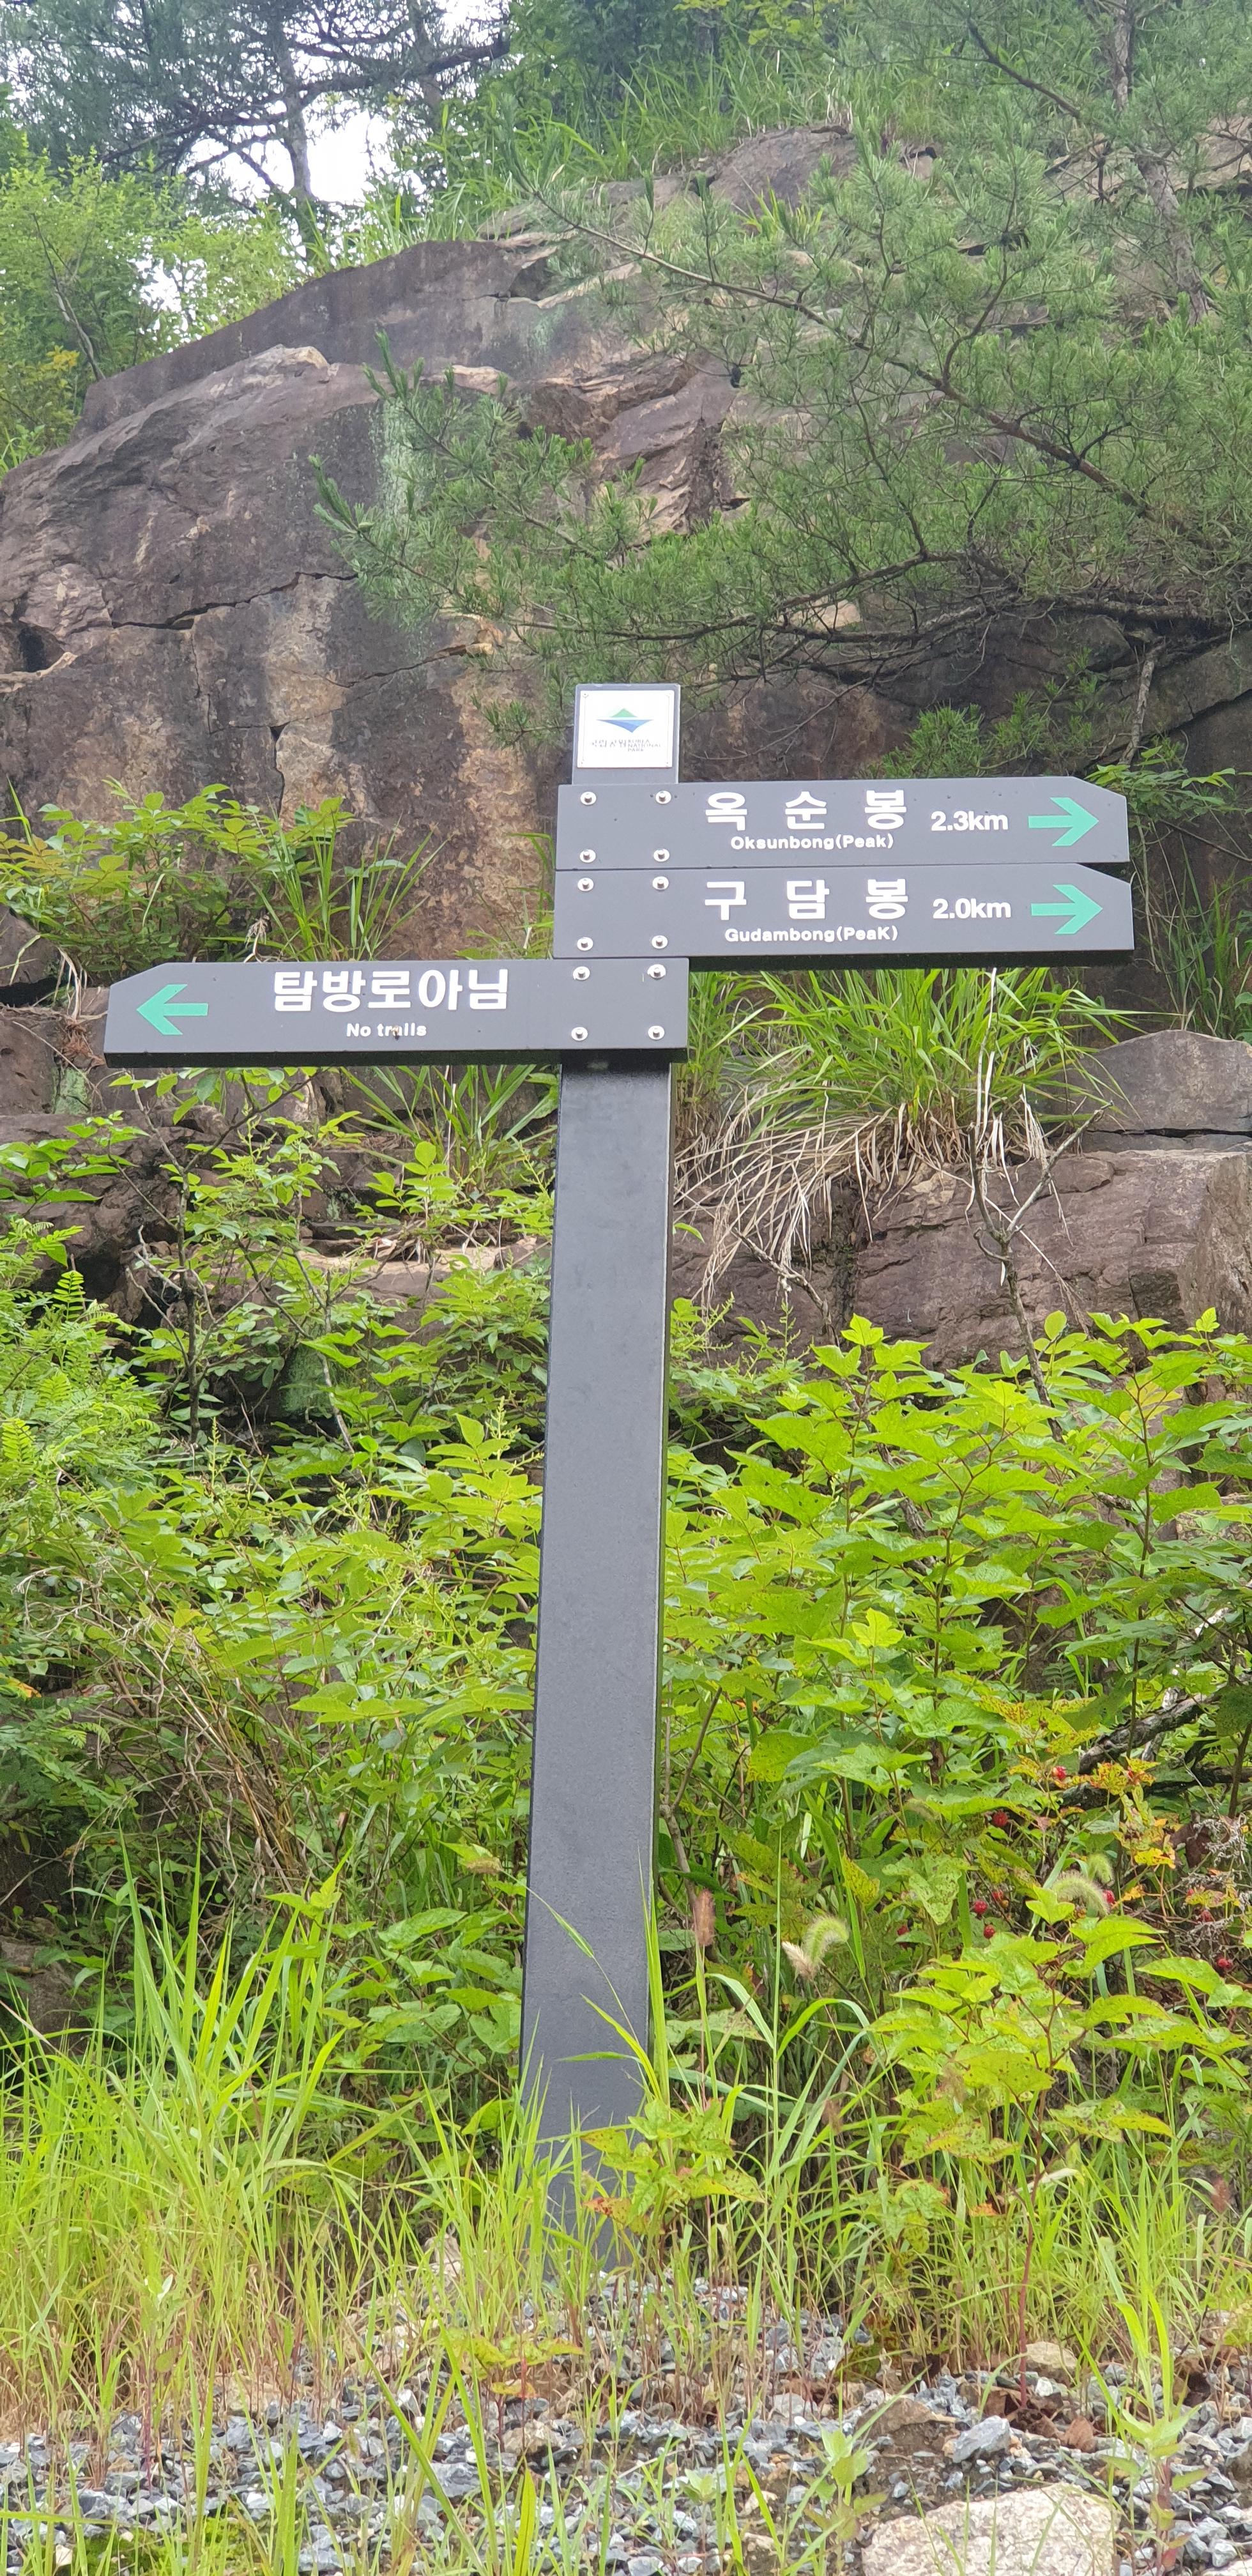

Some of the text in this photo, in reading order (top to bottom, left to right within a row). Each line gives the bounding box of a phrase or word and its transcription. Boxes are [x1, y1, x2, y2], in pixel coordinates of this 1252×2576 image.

[931, 810, 1009, 831] 2.3km
[730, 832, 894, 850] Oksunbong(Peak)
[933, 898, 1011, 919] 2.0km
[346, 1023, 371, 1037] No
